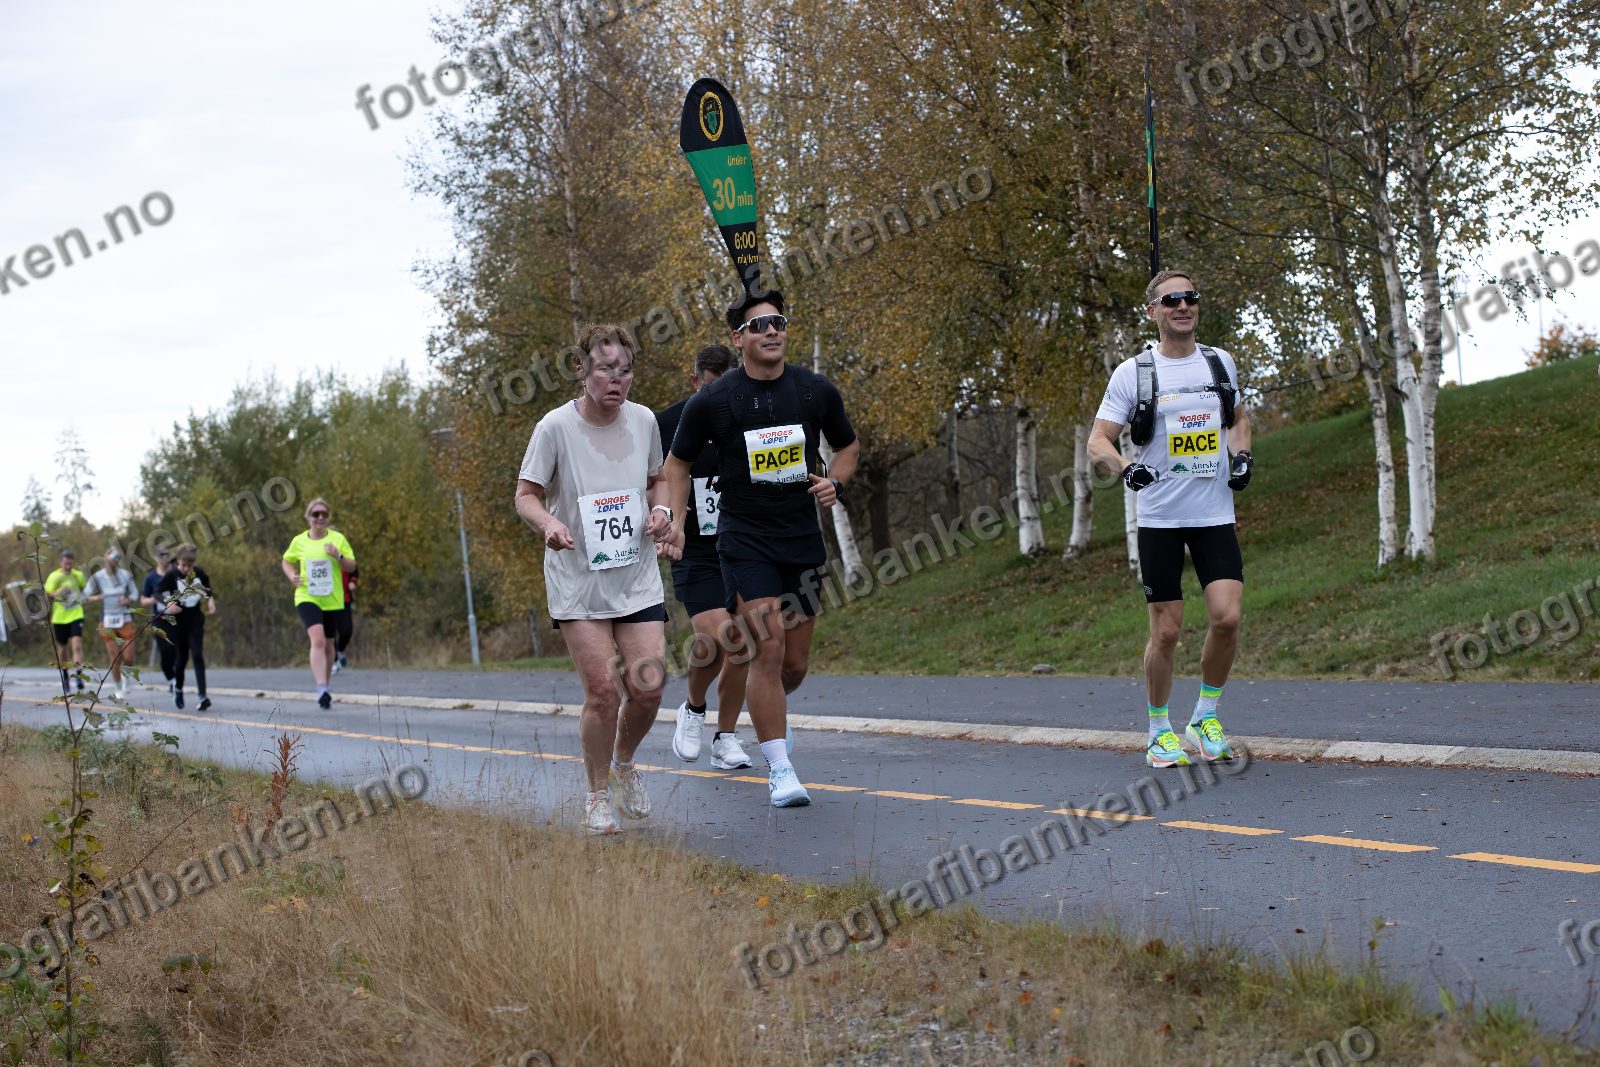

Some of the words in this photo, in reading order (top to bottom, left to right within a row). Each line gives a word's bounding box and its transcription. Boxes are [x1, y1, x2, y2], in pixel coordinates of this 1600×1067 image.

[712, 176, 735, 210] 30
[737, 191, 754, 206] min
[734, 231, 756, 249] 6:00
[1178, 414, 1211, 422] NORGES
[758, 429, 793, 440] NORGES
[763, 435, 789, 445] LØPET
[1173, 433, 1217, 454] PACE
[754, 446, 800, 471] PACE
[594, 494, 630, 507] NORGES
[598, 502, 625, 513] LØPET
[705, 496, 720, 514] 3
[594, 515, 634, 541] 764
[311, 568, 328, 578] 826
